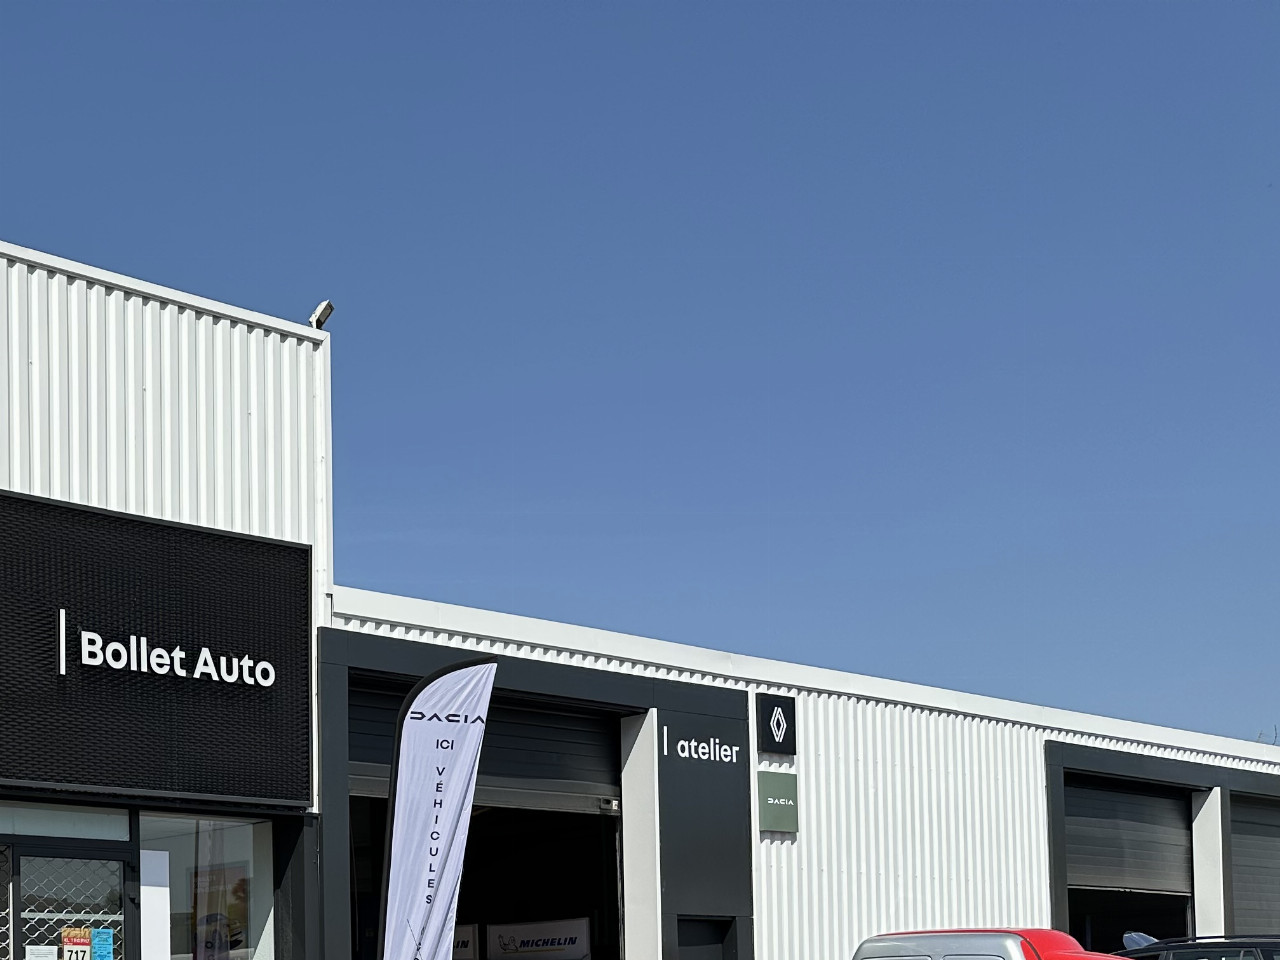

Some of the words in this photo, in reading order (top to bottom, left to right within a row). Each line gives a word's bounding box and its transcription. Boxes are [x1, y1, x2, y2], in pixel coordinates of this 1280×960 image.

[81, 630, 187, 677] Bollet
[192, 647, 276, 687] Auto
[410, 710, 485, 724] DACIA
[436, 738, 454, 750] ICI
[677, 737, 740, 763] atelier
[767, 797, 794, 805] DACIA
[425, 766, 446, 904] VÉHICULES
[519, 936, 578, 949] MICHELIN
